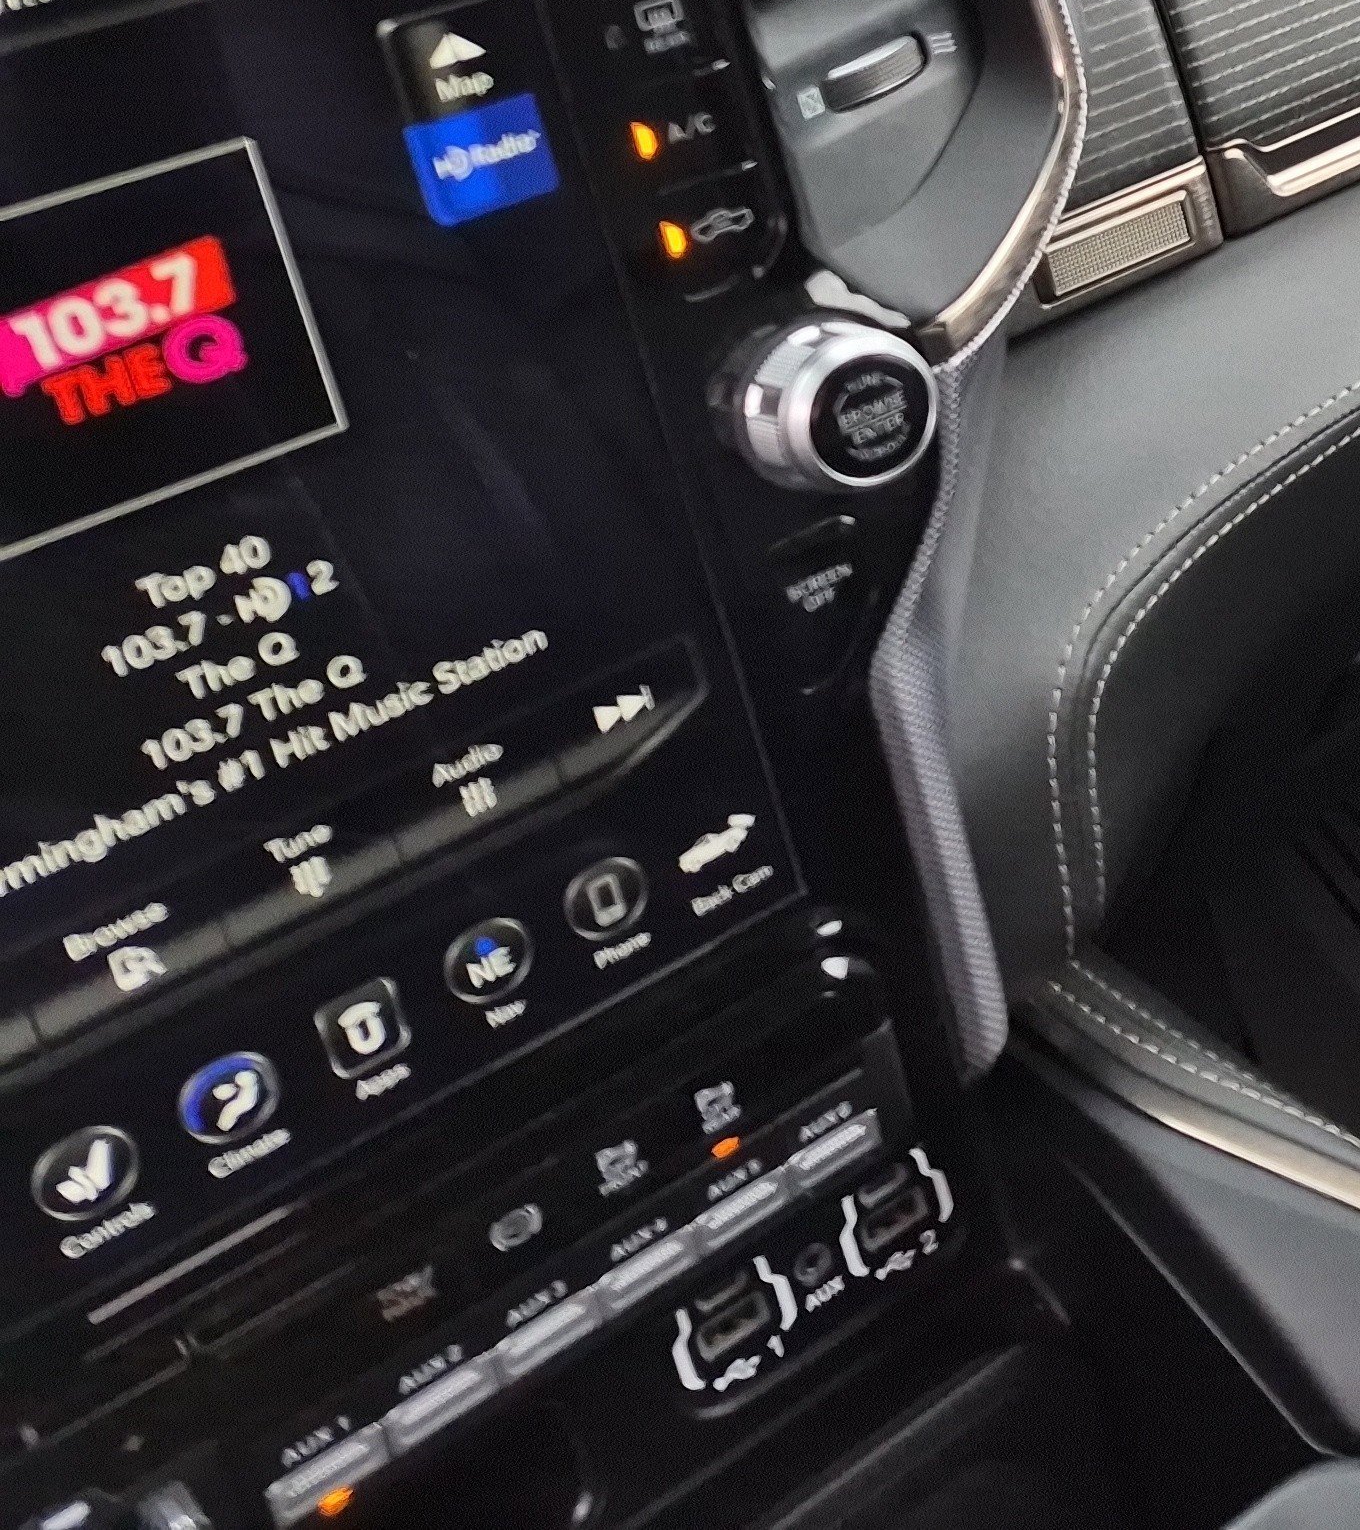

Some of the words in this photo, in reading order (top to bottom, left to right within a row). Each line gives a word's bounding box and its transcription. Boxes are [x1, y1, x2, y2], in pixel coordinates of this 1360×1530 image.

[435, 73, 494, 102] Map
[10, 252, 197, 371] 103.7
[42, 343, 172, 426] THE
[162, 313, 250, 384] Q
[135, 565, 216, 609] Top
[219, 535, 271, 575] 40
[102, 610, 206, 677] 103.7
[176, 655, 255, 699] The
[257, 631, 299, 666] Q
[141, 703, 244, 770] 103.7
[247, 678, 324, 721] The
[326, 655, 367, 689] Q
[217, 750, 265, 792] #1
[270, 725, 331, 768] Hit
[328, 681, 434, 742] Music
[432, 629, 549, 695] Station
[432, 743, 503, 788] Audio
[263, 824, 332, 863] Tune
[593, 931, 652, 970] Phone
[805, 1275, 846, 1313] AUX
